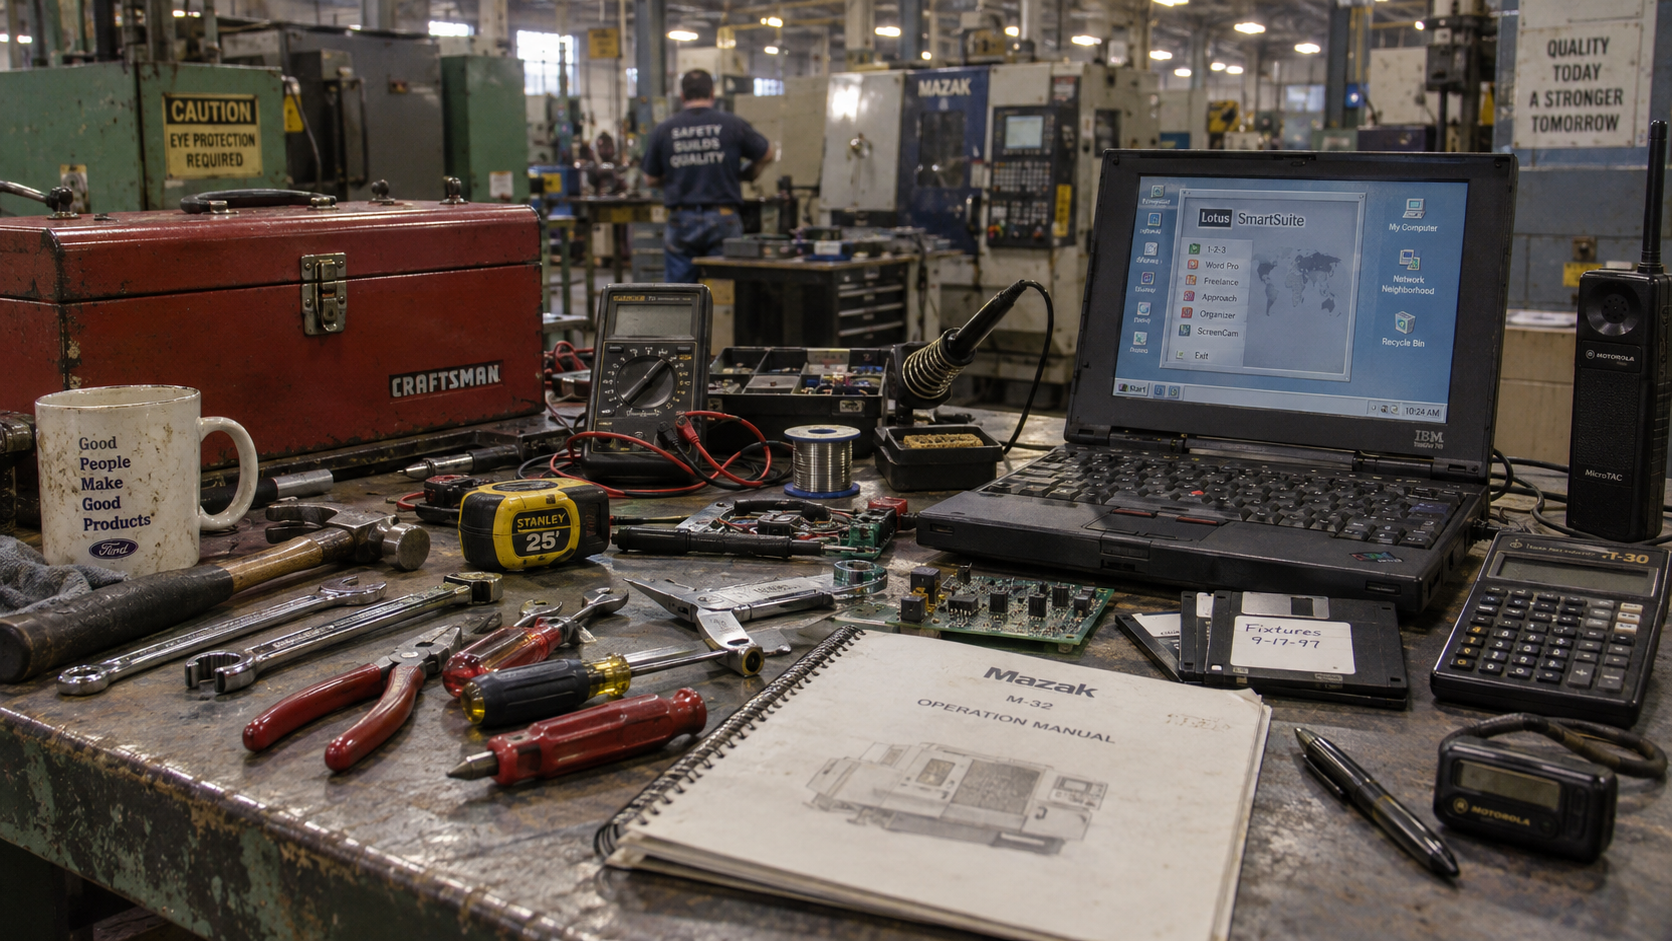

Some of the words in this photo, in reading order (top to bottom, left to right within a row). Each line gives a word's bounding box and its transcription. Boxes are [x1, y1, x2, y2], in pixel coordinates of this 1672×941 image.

[1547, 36, 1610, 58] QUALITY
[1553, 63, 1601, 82] TODAY
[918, 78, 972, 97] MAZAK
[1529, 91, 1539, 108] A
[1544, 88, 1623, 108] STRONGER
[171, 100, 251, 122] CAUTION
[1531, 114, 1619, 133] TOMORROW
[671, 124, 722, 139] SAFETY
[170, 132, 189, 148] EYE
[193, 133, 255, 147] PROTECTION
[186, 152, 243, 168] REQUIRED
[669, 151, 725, 168] QUALITY
[1201, 211, 1230, 223] Lotus
[1238, 212, 1305, 227] SmartSuite
[1388, 223, 1400, 233] My
[1402, 223, 1438, 233] Computer
[1205, 261, 1225, 270] Word
[1227, 262, 1239, 270] Pro
[1204, 277, 1239, 287] Freelance
[1393, 275, 1424, 284] Network
[1382, 285, 1435, 295] Neighborhood
[1202, 293, 1237, 303] Approach
[1200, 310, 1236, 320] Organizer
[1197, 327, 1239, 338] ScreenCam
[1382, 338, 1411, 348] Recycle
[1413, 339, 1425, 348] Bin
[1195, 352, 1208, 360] Exit
[392, 364, 500, 398] CRAFTSMAN
[1405, 407, 1425, 416] 10:24
[1427, 409, 1440, 417] AM
[79, 436, 117, 450] Good
[1414, 430, 1444, 443] IBM
[80, 455, 131, 472] People
[1585, 469, 1623, 482] MicroTAC
[81, 476, 123, 491] Make
[82, 496, 121, 511] Good
[83, 514, 151, 531] Products
[517, 513, 566, 528] STANLEY
[526, 530, 560, 552] 25'
[1245, 623, 1322, 637] Fixtures
[1251, 636, 1321, 649] 9-17-97
[983, 666, 1098, 698] Mazak
[1005, 694, 1054, 710] M-32
[917, 698, 1028, 726] OPERATION
[1032, 720, 1116, 744] MANUAL
[1471, 805, 1530, 826] MOTOROLA
